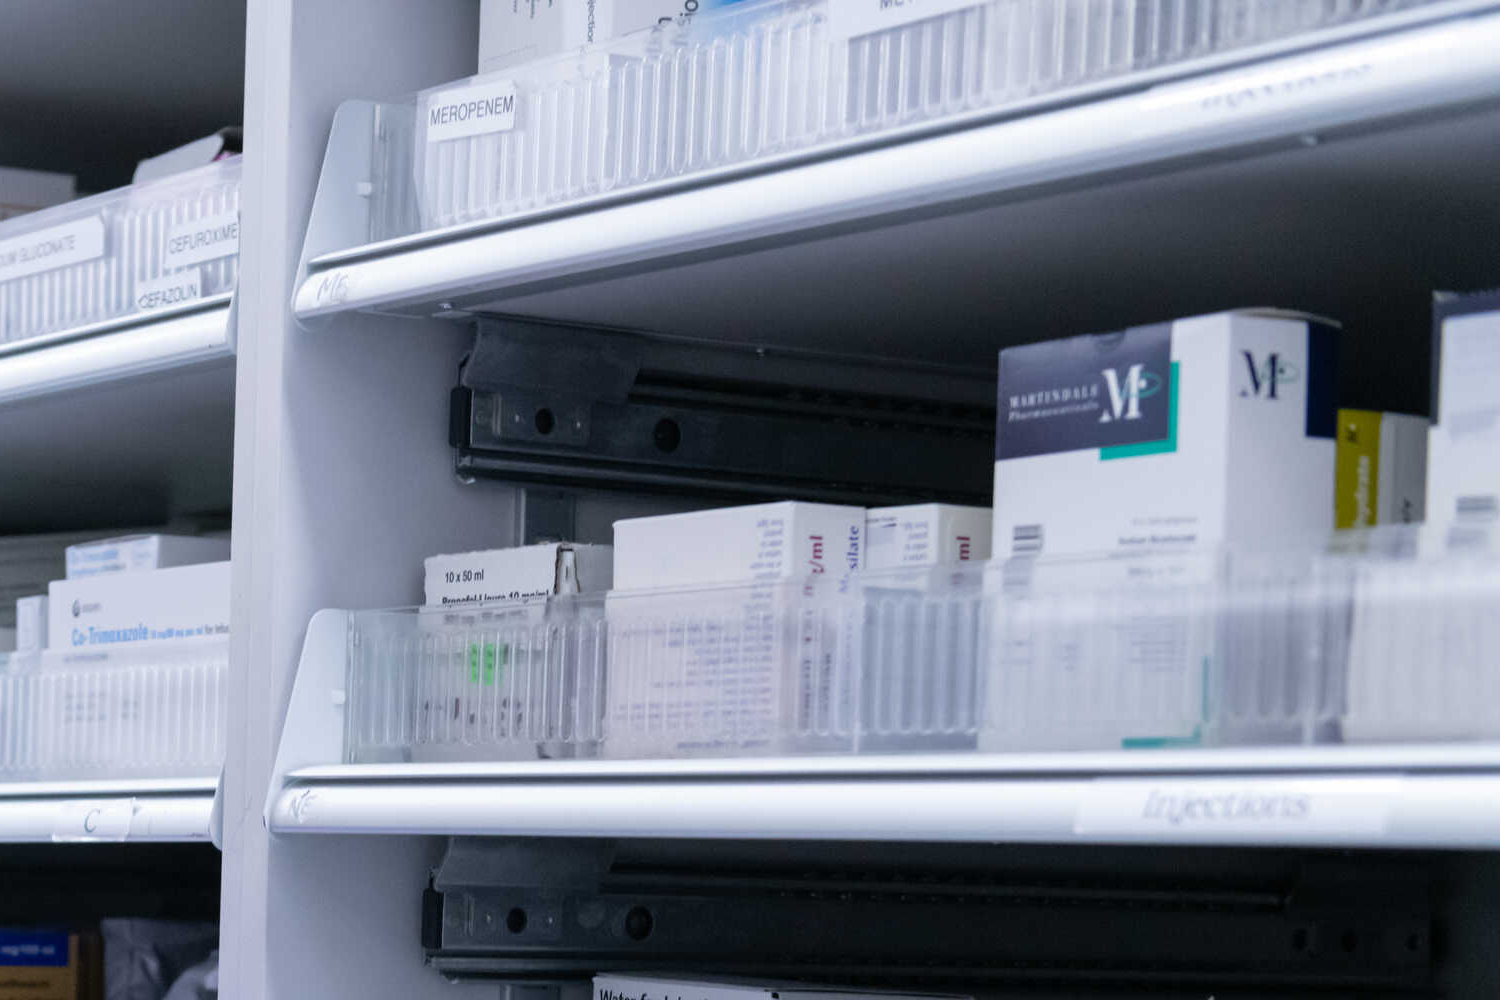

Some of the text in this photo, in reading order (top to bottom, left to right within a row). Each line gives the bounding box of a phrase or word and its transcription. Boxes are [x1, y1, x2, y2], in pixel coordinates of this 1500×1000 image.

[430, 95, 514, 126] MEROPENEM
[168, 223, 238, 255] CEFUROXIME
[140, 283, 197, 309] CEFAZOLIN
[1009, 384, 1098, 409] MARTINDALE
[445, 569, 484, 583] 10 x 50 ml
